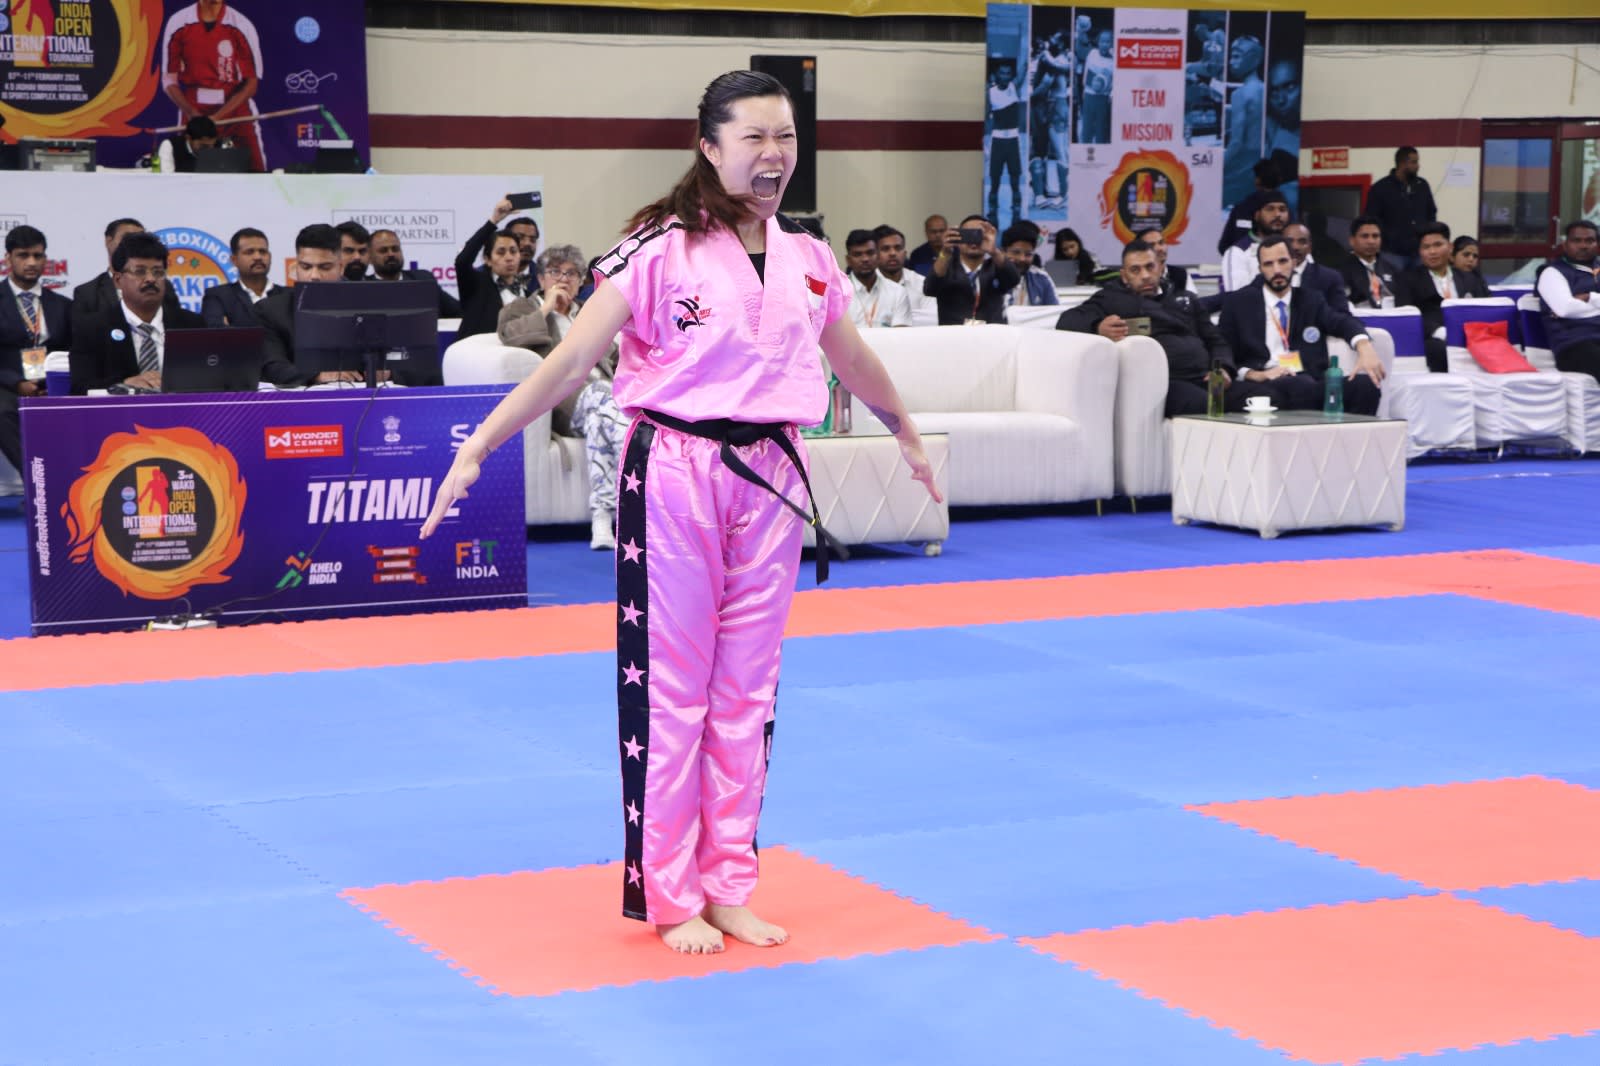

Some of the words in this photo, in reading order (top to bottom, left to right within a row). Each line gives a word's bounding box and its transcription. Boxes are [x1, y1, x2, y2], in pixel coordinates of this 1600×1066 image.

[60, 3, 92, 17] INDIA
[55, 18, 92, 36] OPEN
[1131, 89, 1165, 108] TEAM
[1122, 123, 1173, 141] MISSION
[350, 215, 405, 226] MEDICAL
[409, 215, 439, 225] AND
[291, 431, 338, 440] WONDER
[293, 439, 338, 447] CEMENT
[171, 480, 195, 490] WAKO
[173, 490, 195, 501] INDIA
[307, 477, 432, 525] TATAMI
[169, 500, 196, 514] OPEN
[309, 561, 342, 573] KHELO
[456, 564, 500, 579] INDIA
[309, 572, 337, 585] INDIA
